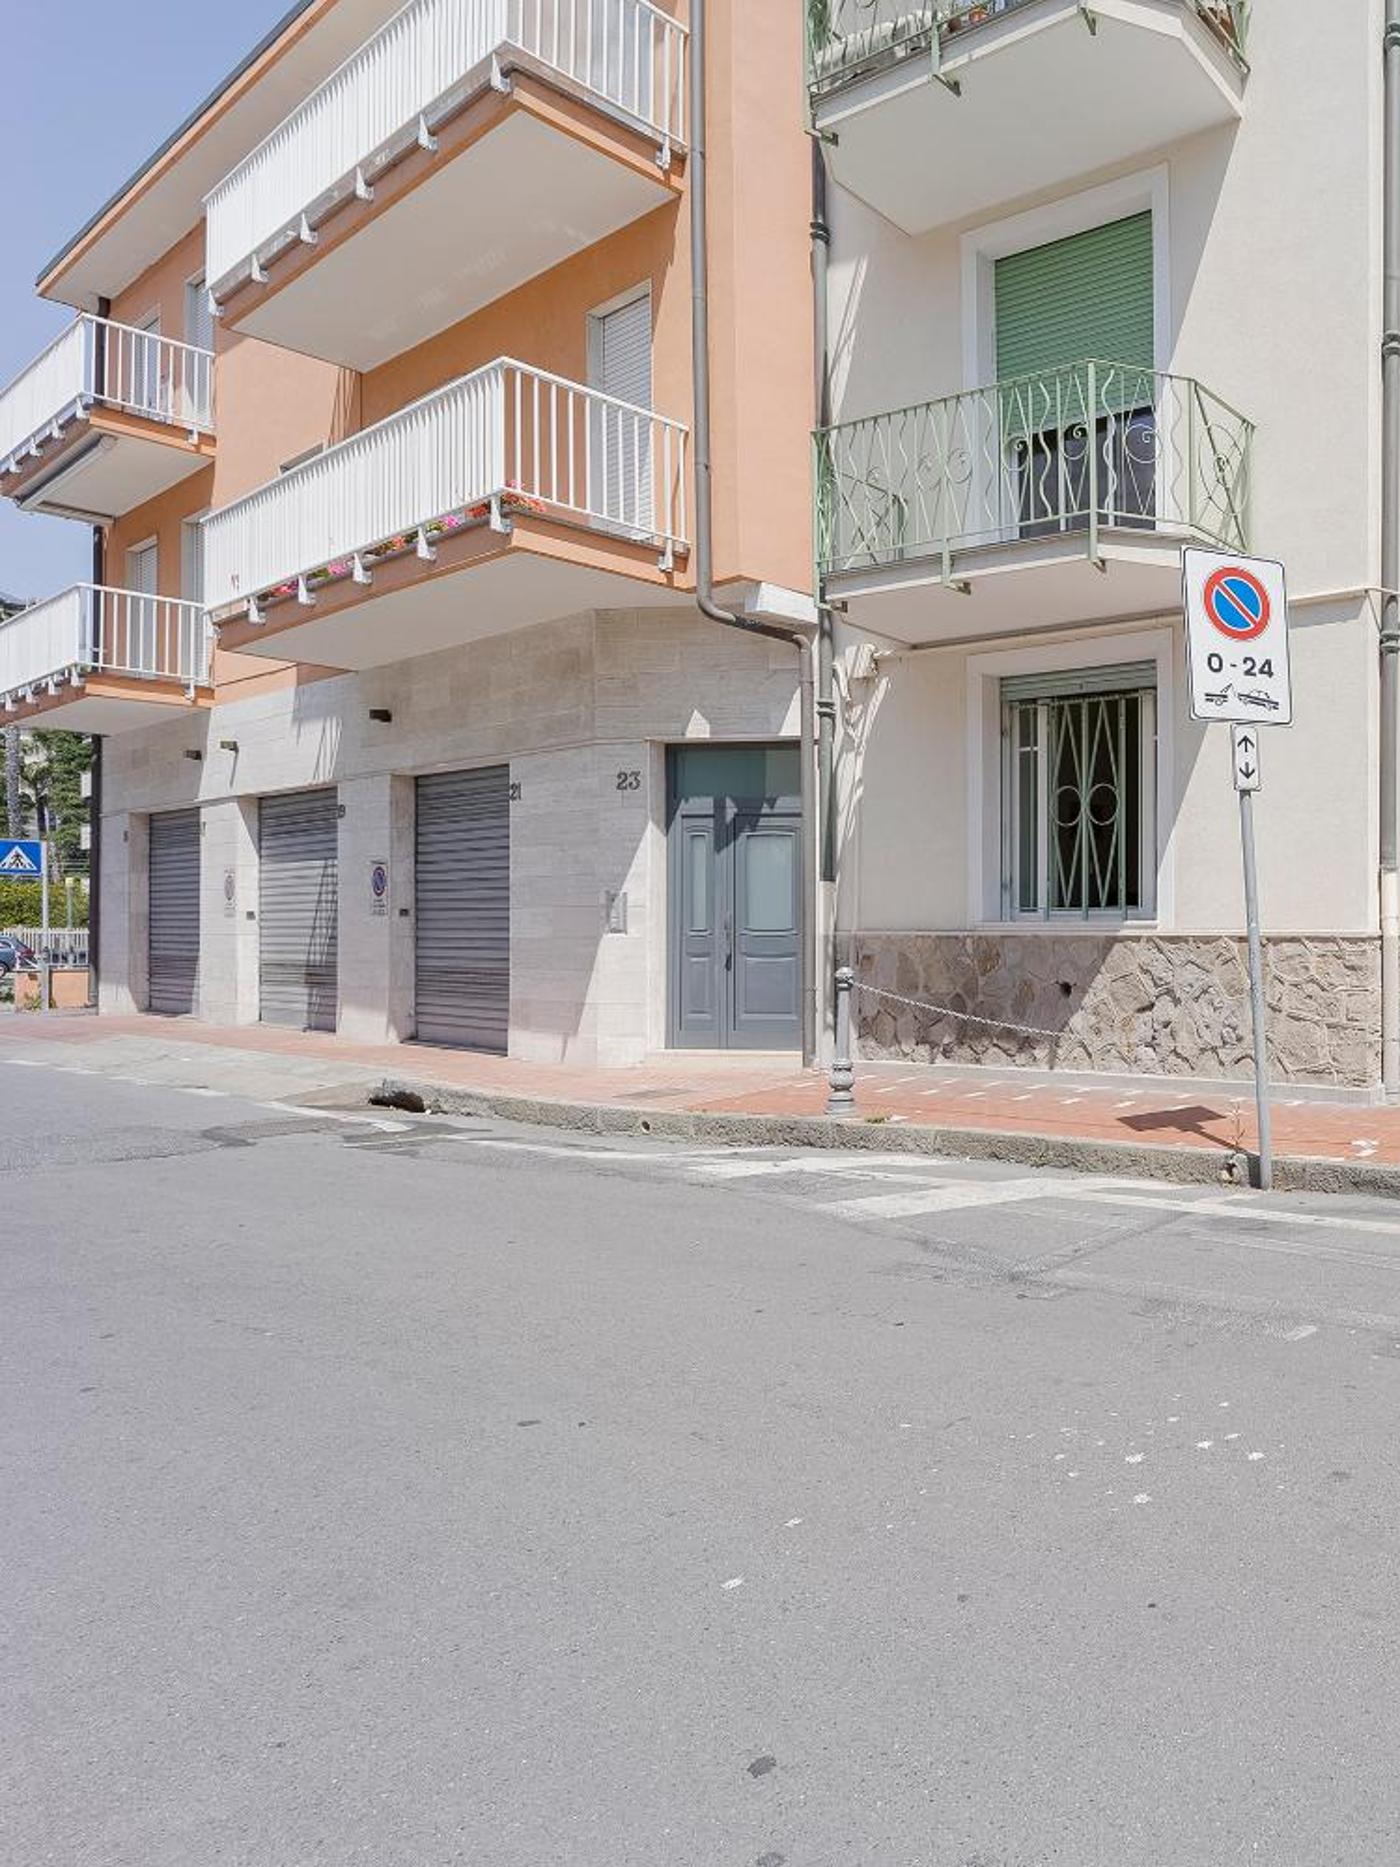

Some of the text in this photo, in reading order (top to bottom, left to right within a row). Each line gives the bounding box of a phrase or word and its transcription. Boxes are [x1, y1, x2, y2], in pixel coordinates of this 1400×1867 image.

[1207, 653, 1223, 673] 0
[1242, 656, 1274, 678] 24
[616, 770, 641, 791] 23
[509, 782, 522, 801] 21
